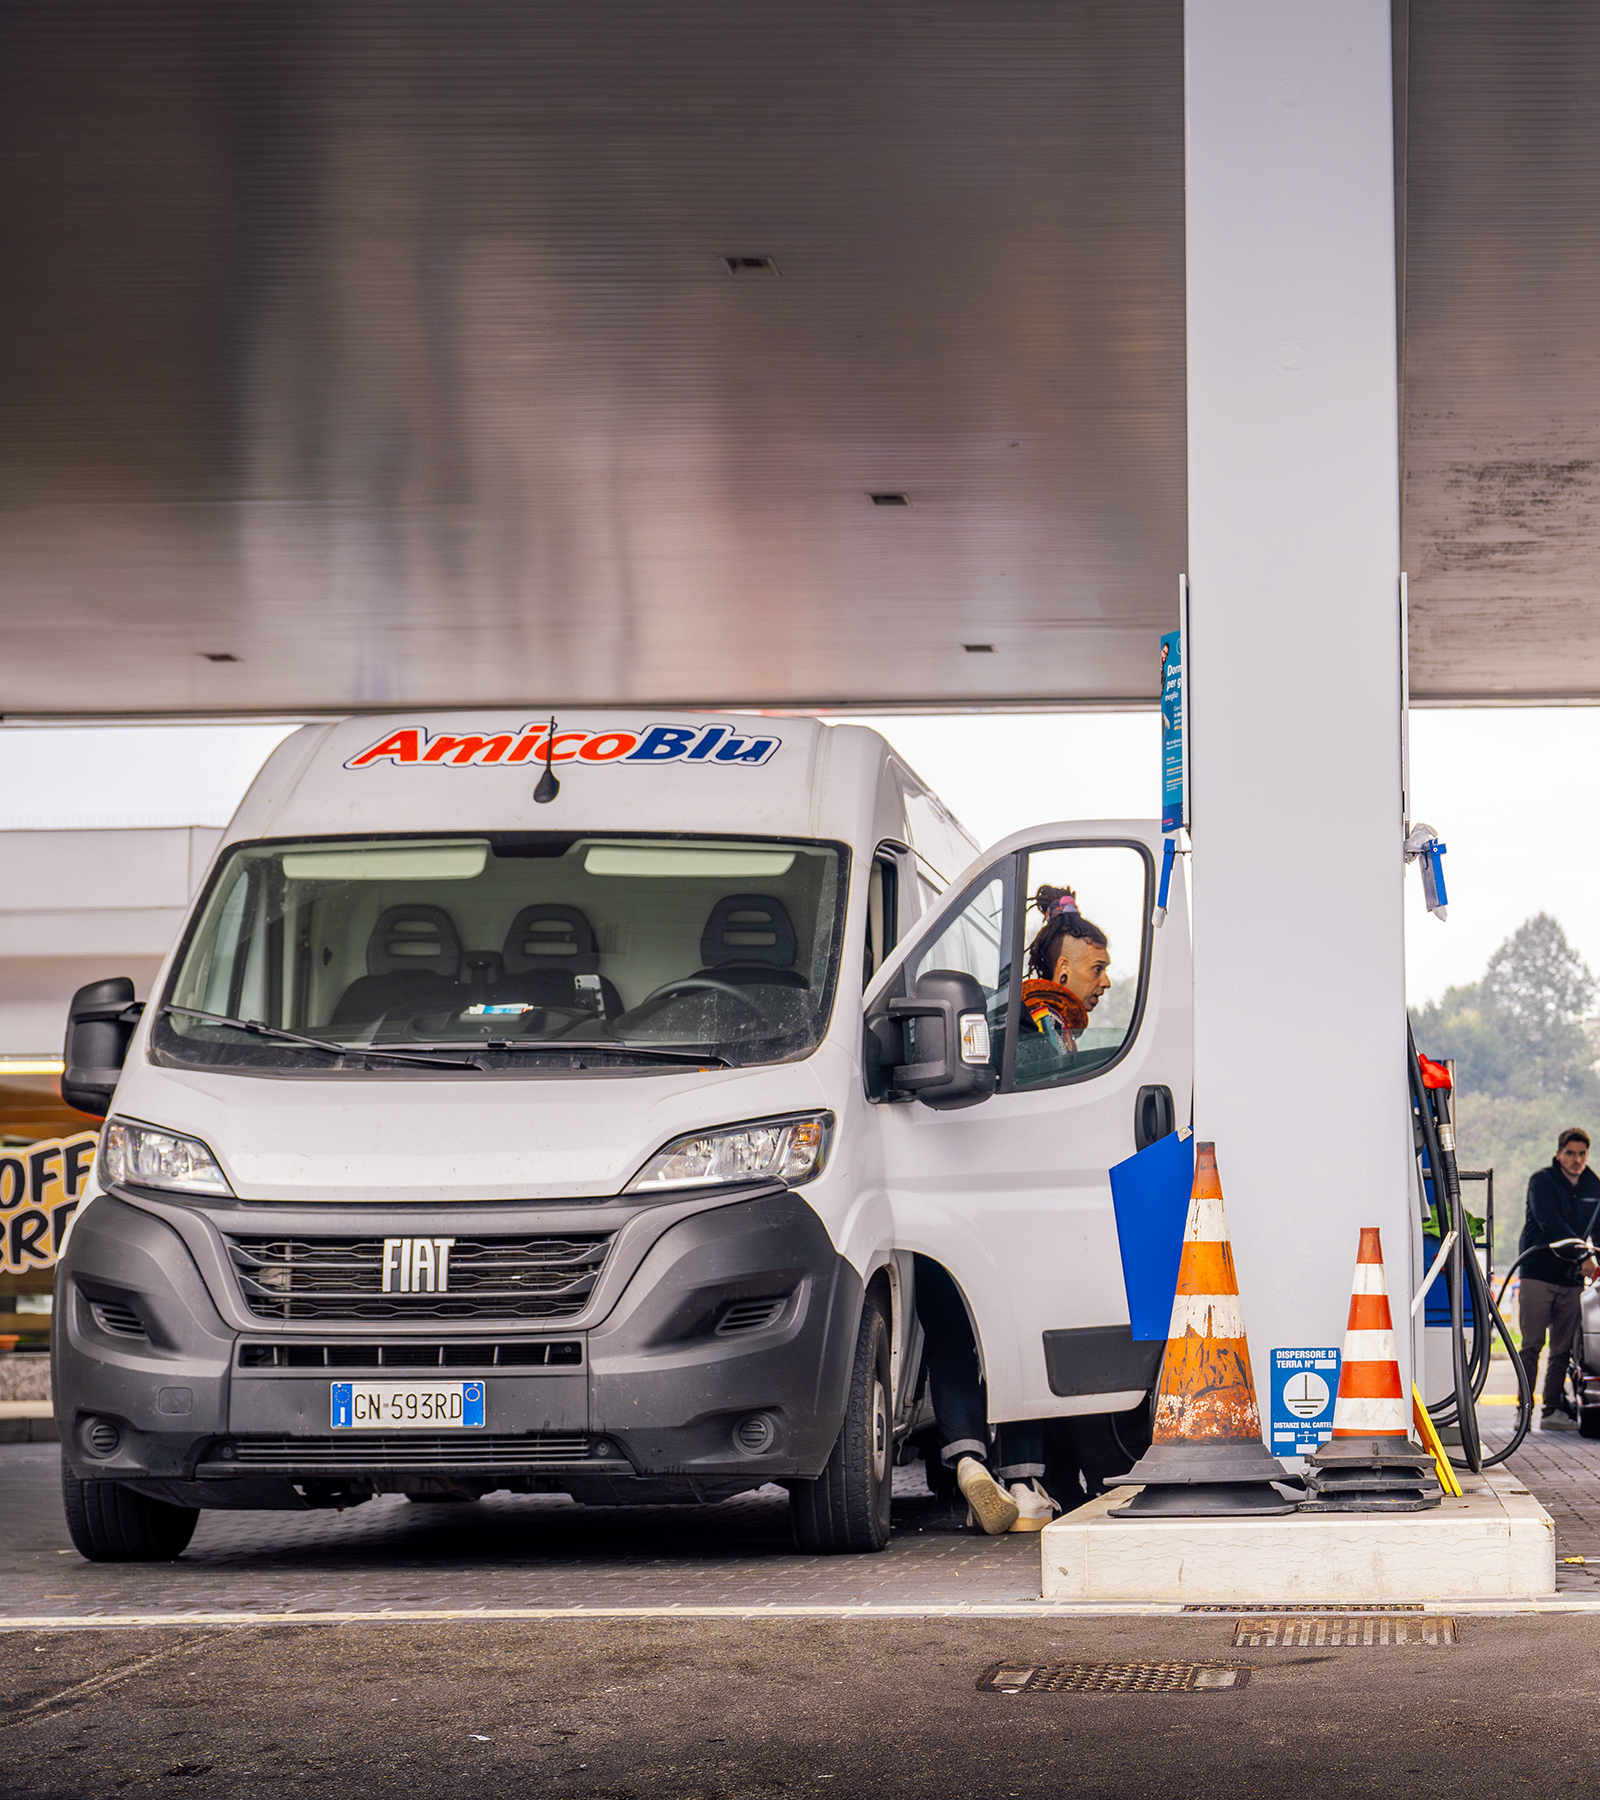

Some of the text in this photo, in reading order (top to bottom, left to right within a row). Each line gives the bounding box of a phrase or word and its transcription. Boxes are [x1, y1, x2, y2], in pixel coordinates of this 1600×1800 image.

[351, 725, 774, 765] AmicoBlu
[382, 1238, 456, 1292] FIAT
[1276, 1360, 1302, 1368] TERRA
